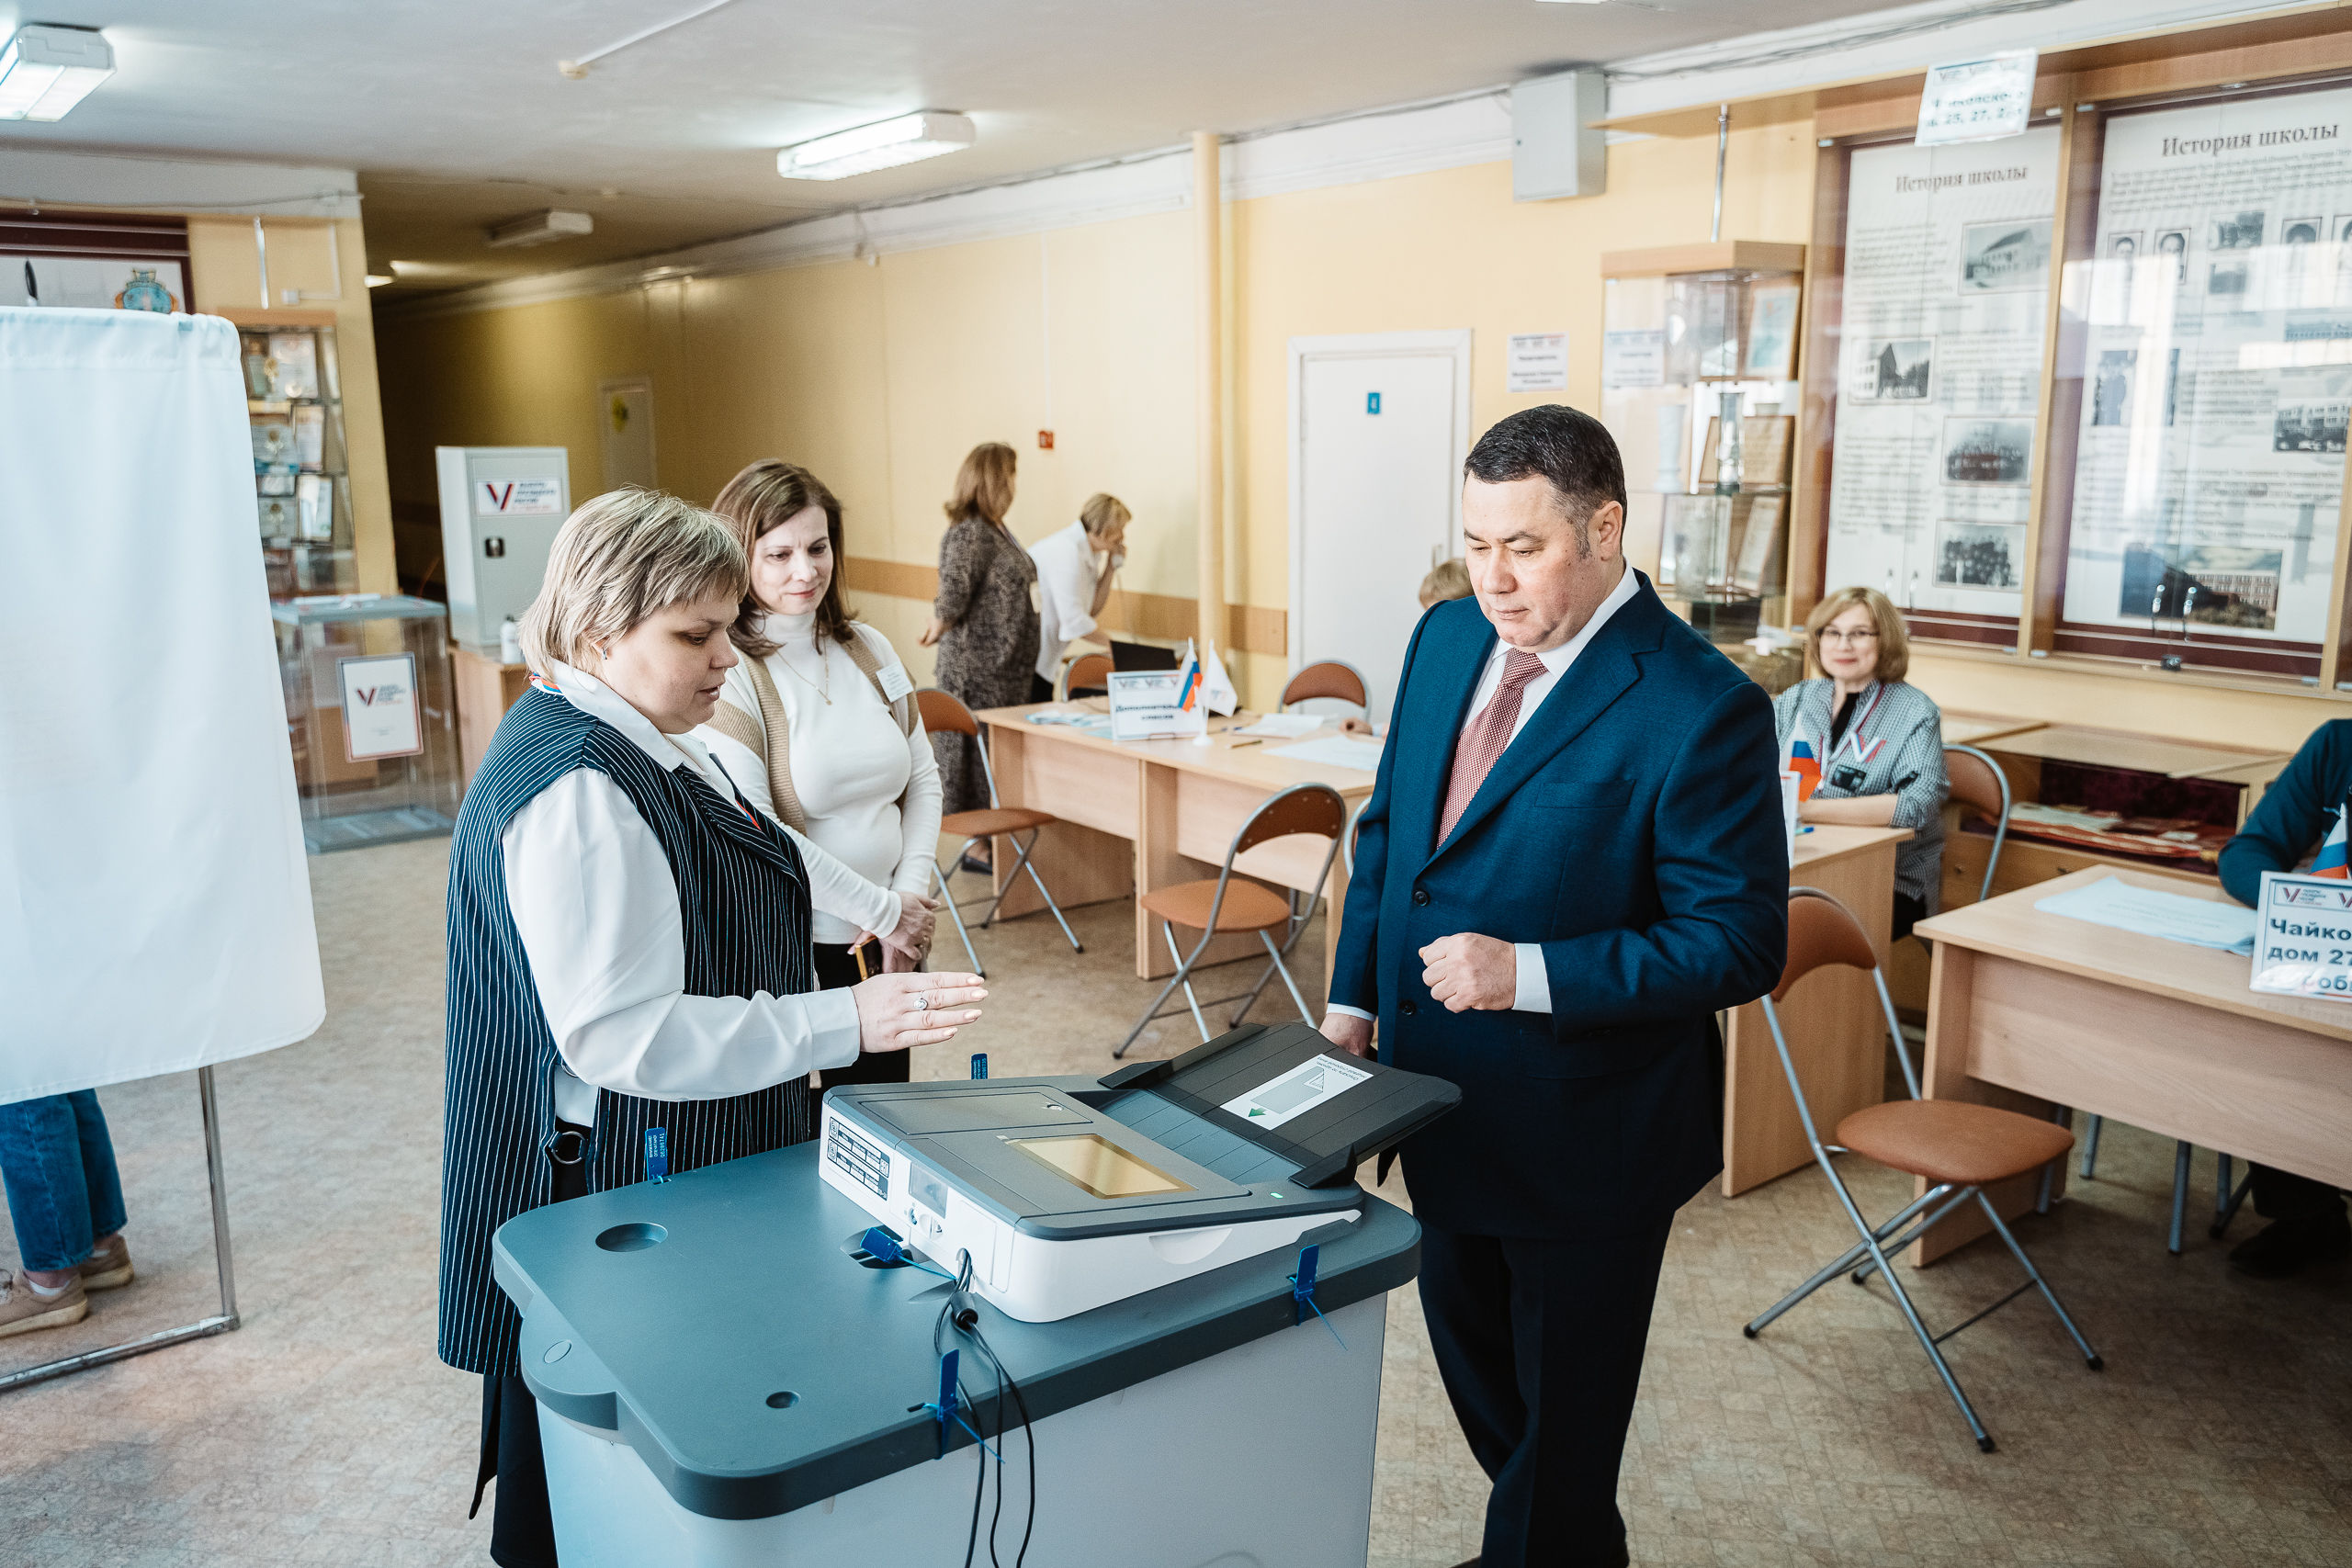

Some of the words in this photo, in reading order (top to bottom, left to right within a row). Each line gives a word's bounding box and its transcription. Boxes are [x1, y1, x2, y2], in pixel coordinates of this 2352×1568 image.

[2162, 134, 2252, 157] История
[2258, 124, 2339, 146] школы
[1895, 175, 1962, 194] История
[1968, 167, 2029, 185] школы
[2269, 918, 2352, 941] Чайко
[2267, 946, 2319, 963] дом
